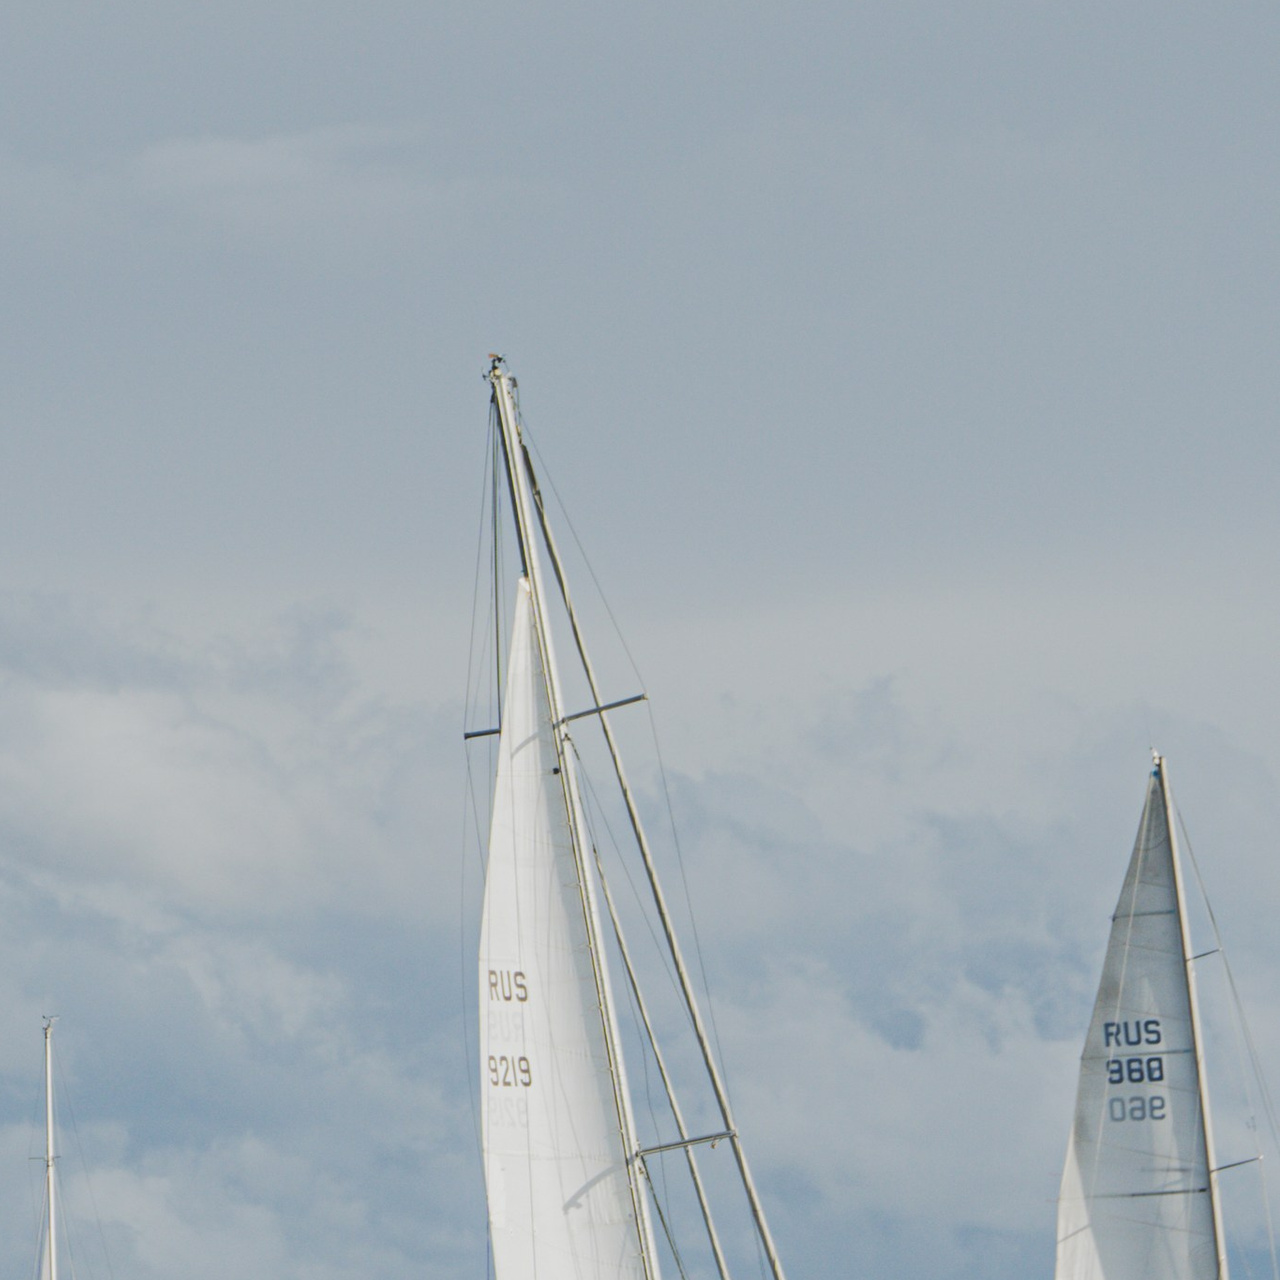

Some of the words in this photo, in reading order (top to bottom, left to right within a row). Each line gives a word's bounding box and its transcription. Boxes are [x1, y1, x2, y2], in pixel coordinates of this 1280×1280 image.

[488, 970, 528, 1002] RUS
[1103, 1020, 1162, 1047] RUS
[488, 1055, 532, 1087] 9219
